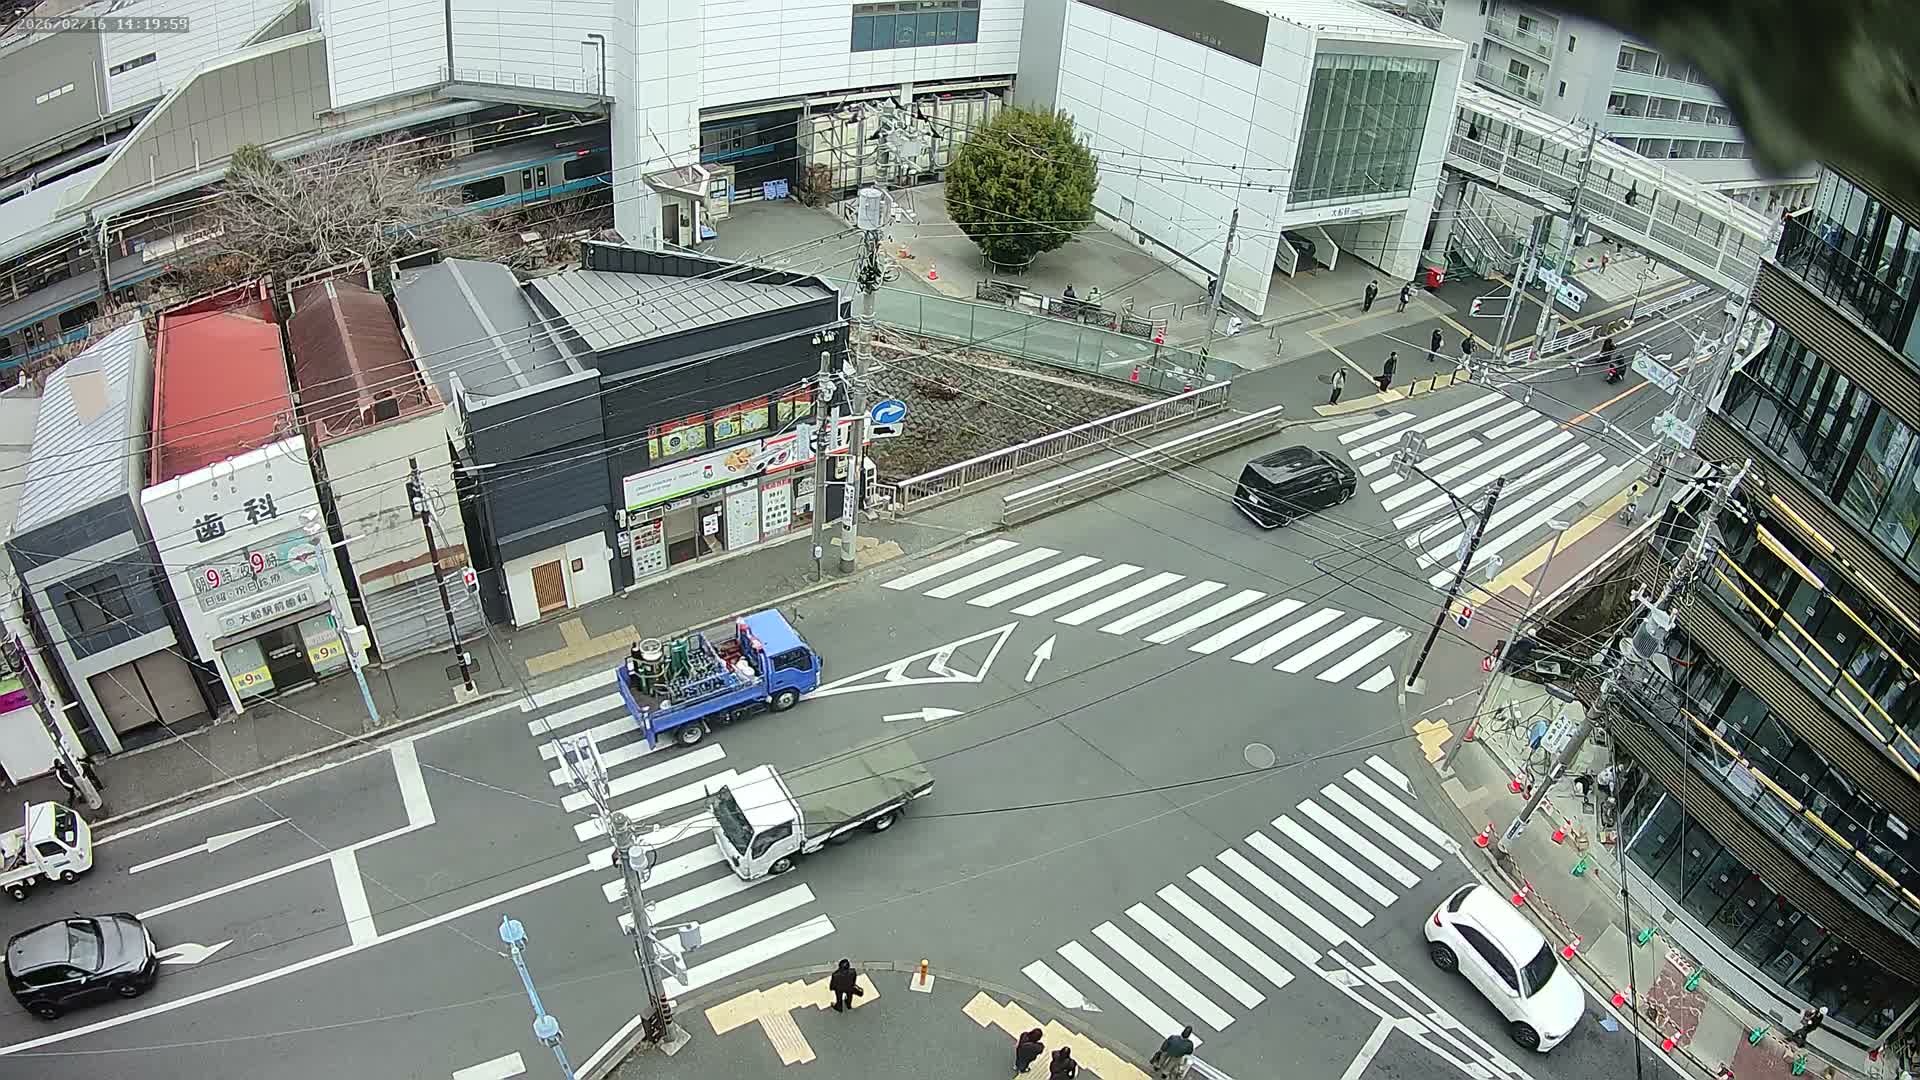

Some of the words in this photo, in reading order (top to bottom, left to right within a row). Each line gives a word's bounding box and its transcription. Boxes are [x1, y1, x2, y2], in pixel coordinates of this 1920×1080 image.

[193, 493, 277, 542] 歯科
[240, 592, 308, 625] 大船駅前歯科
